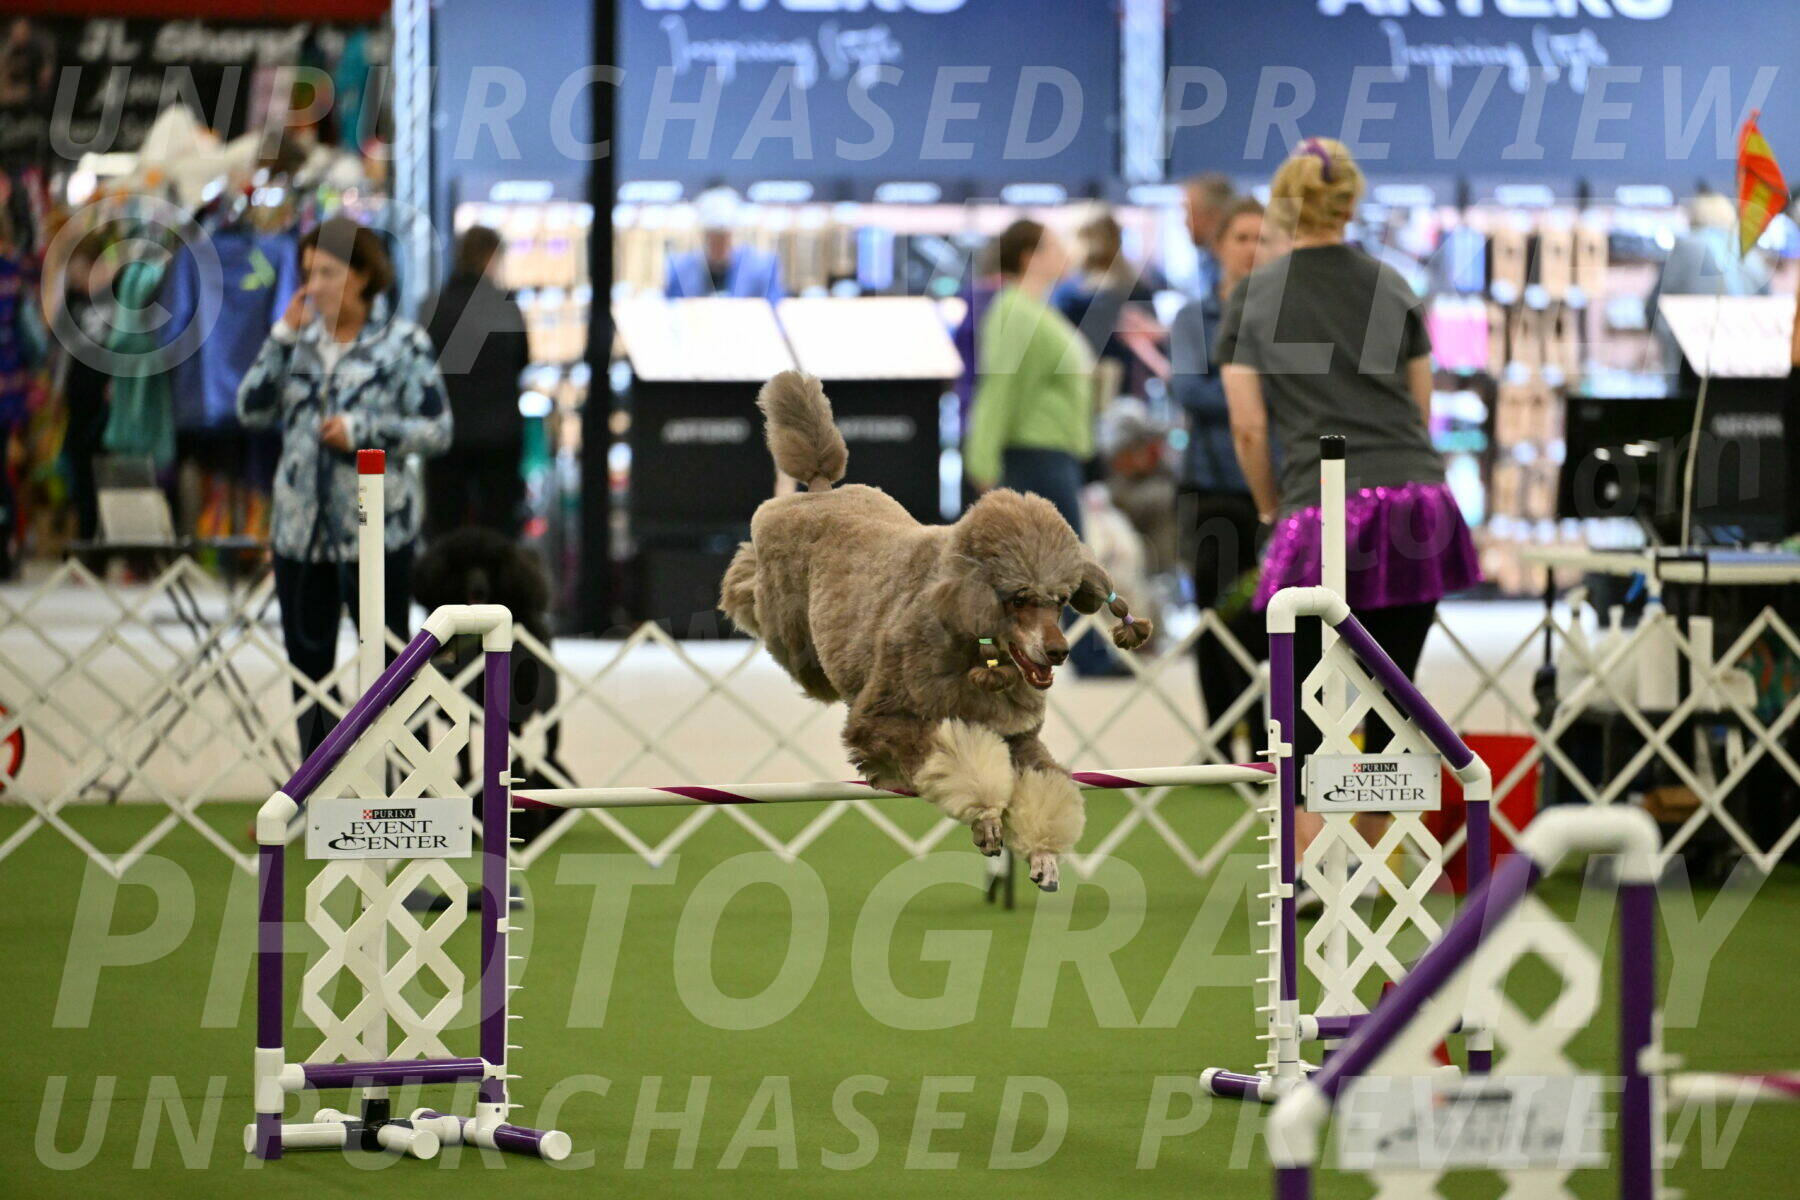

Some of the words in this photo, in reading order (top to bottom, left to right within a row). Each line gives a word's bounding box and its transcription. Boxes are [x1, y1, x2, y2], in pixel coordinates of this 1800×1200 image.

[1362, 763, 1397, 772] PURINA
[1343, 774, 1412, 787] EVENT
[1323, 788, 1425, 802] CENTER
[374, 809, 415, 818] PURINA
[350, 820, 433, 835] EVENT
[328, 835, 448, 850] CENTER
